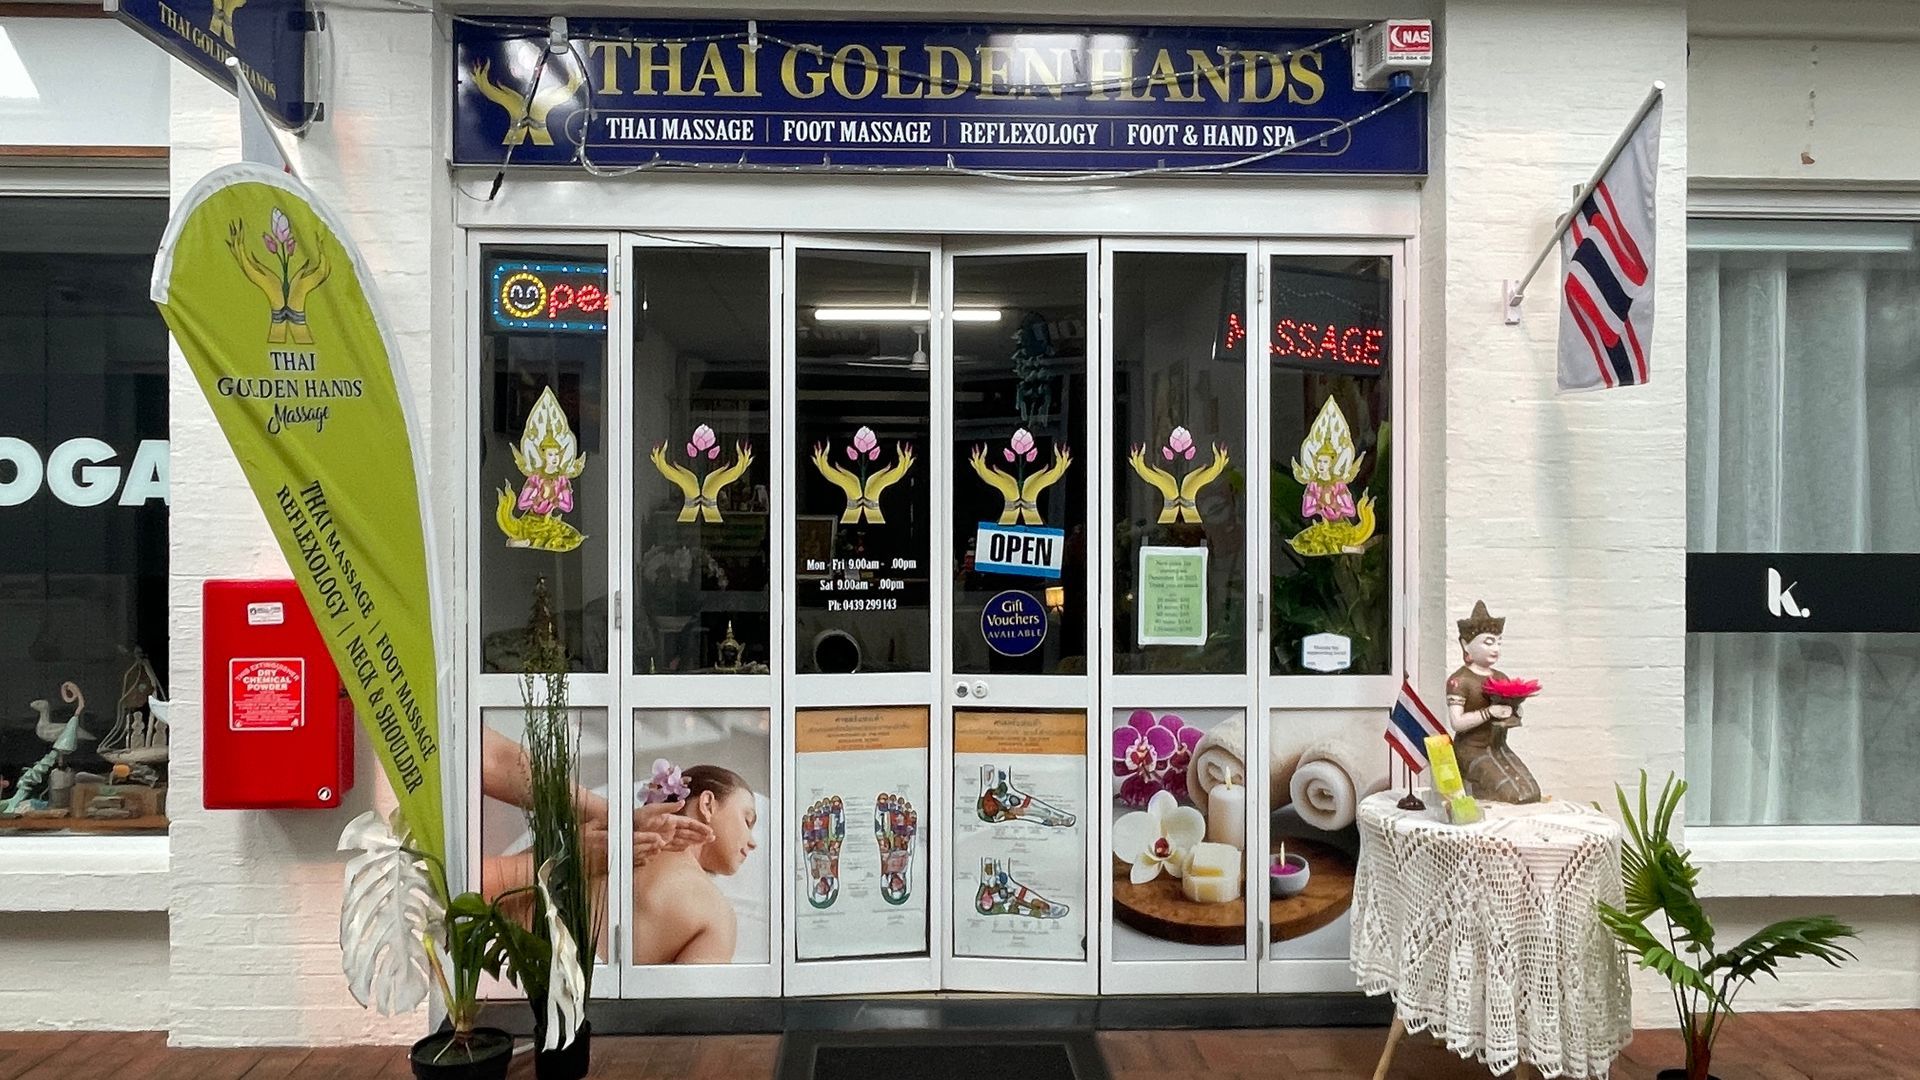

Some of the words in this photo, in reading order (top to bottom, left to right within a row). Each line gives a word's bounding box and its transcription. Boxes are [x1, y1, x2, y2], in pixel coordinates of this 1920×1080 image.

[158, 1, 191, 40] THAI
[192, 28, 234, 64] GOLD
[1402, 31, 1430, 43] NAS
[589, 41, 762, 97] THAI
[780, 43, 1066, 101] GOLDEN
[1087, 47, 1326, 105] HANDS
[606, 118, 656, 140] THAI
[661, 118, 754, 141] MASSAGE
[783, 120, 835, 142] FOOT
[839, 121, 931, 143] MASSAGE
[959, 122, 1098, 146] REFLEXOLOGY
[1127, 123, 1178, 146] FOOT
[1182, 124, 1199, 146] &
[1203, 124, 1258, 147] HAND
[1262, 125, 1296, 147] SPA
[1225, 313, 1384, 366] MSSAGE
[270, 352, 316, 371] THAI
[305, 379, 362, 398] HANDS
[267, 403, 329, 434] Massage
[276, 484, 349, 619] REFLEXOLOGY
[989, 533, 1053, 567] OPEN
[806, 559, 825, 570] Mon
[832, 559, 845, 570] Fri
[848, 558, 879, 569] 9.00am
[820, 580, 834, 590] Sat
[837, 580, 869, 590] 9.00am
[1767, 567, 1811, 618] k.
[828, 600, 841, 611] Ph:
[843, 600, 864, 611] 0439
[865, 599, 882, 610] 299
[883, 599, 897, 610] 143
[1001, 599, 1024, 613] Gift
[300, 480, 333, 532] THAI
[325, 530, 375, 619] MASSAGE
[376, 632, 404, 684] FOOT
[396, 681, 437, 762] MASSAGE
[987, 614, 1040, 626] Vouchers
[987, 629, 1042, 639] AVAILABLE
[257, 669, 277, 677] DRY
[345, 634, 378, 690] NECK
[242, 676, 292, 685] CHEMICAL
[246, 683, 288, 691] POWDER
[368, 687, 385, 707] &
[376, 703, 424, 794] SHOULDER
